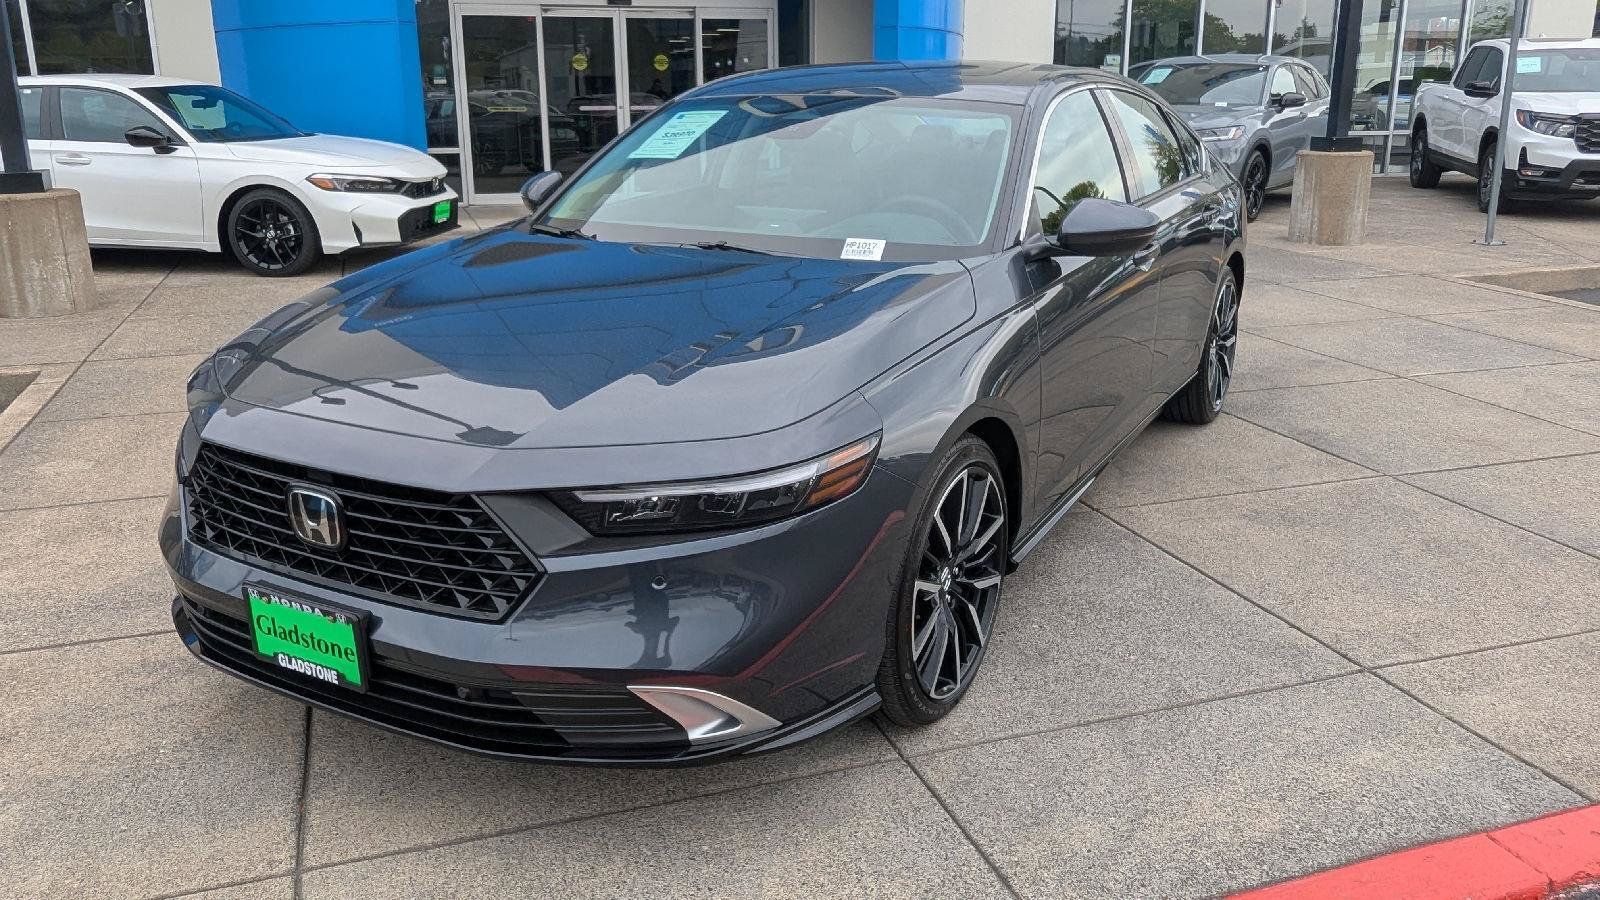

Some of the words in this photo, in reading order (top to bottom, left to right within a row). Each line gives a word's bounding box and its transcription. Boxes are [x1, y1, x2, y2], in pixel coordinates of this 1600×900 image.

[845, 240, 878, 250] HP1017
[255, 614, 356, 663] Gladstone
[278, 653, 339, 685] GLADSTONE
